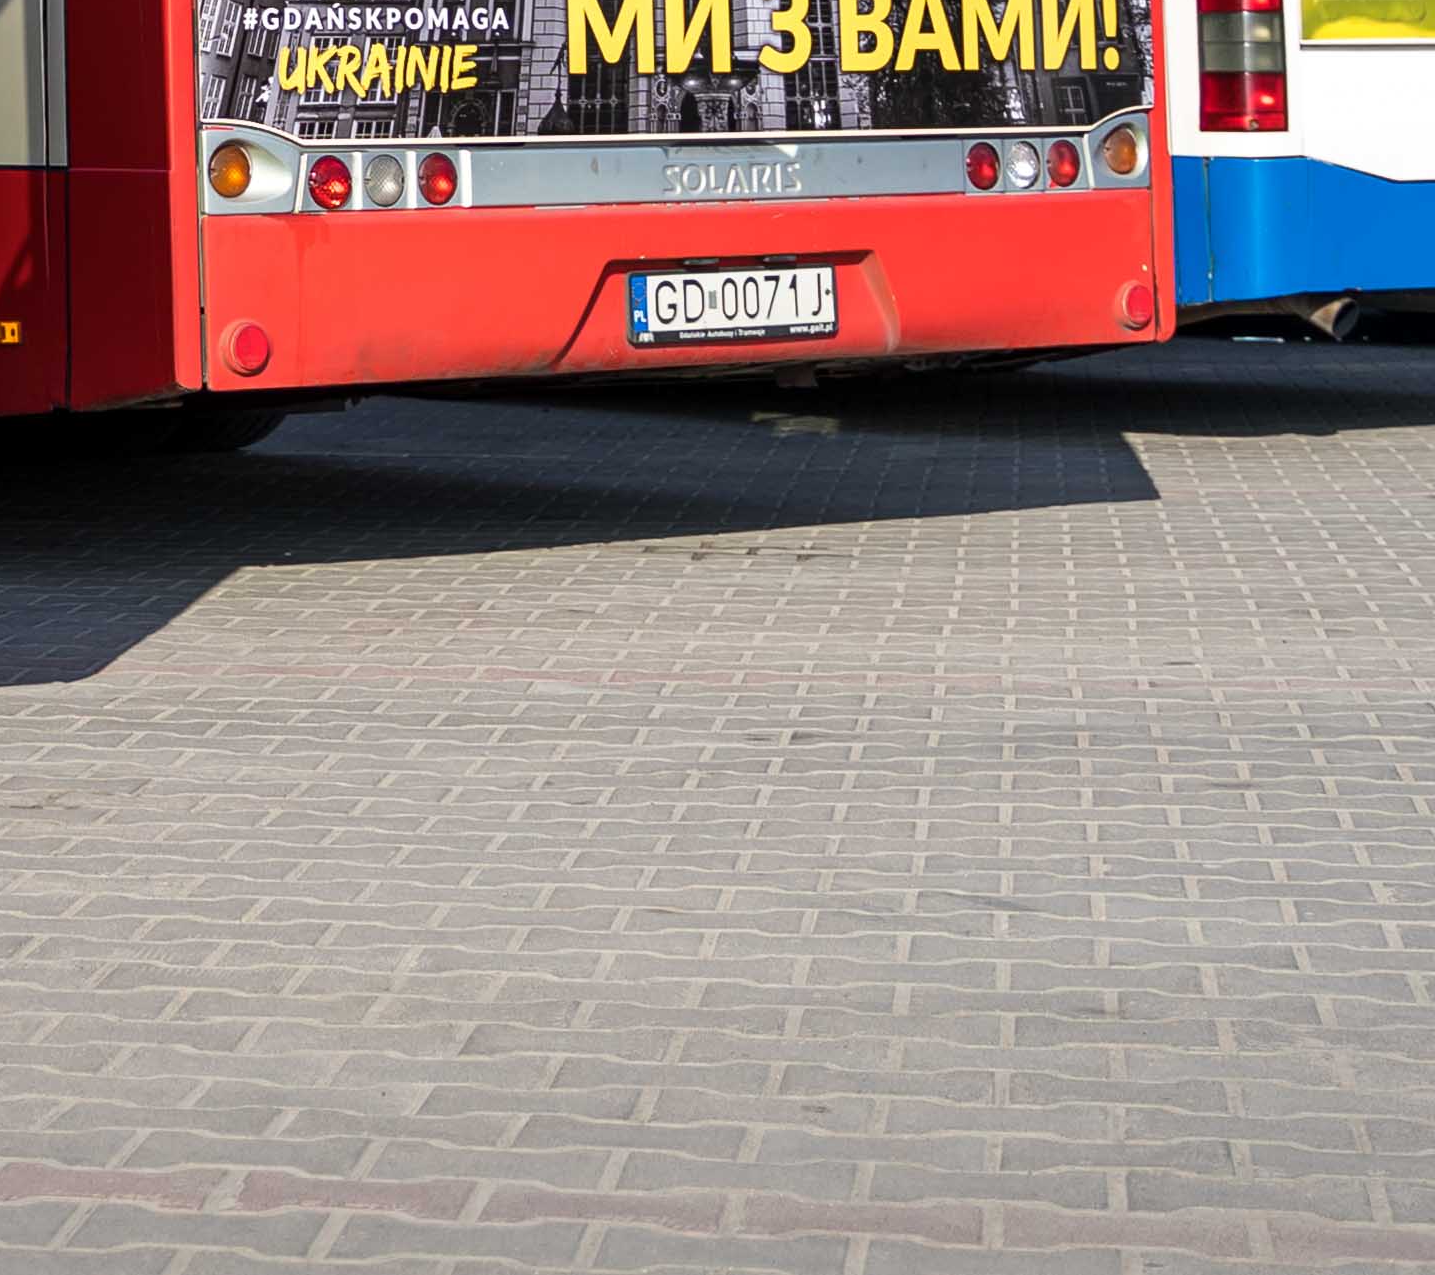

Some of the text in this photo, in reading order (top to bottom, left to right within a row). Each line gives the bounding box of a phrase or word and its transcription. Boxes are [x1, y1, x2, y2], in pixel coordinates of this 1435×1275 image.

[243, 1, 510, 31] #GDAŃSKPOMAGA
[278, 42, 478, 99] UKRAINIE
[662, 161, 802, 195] SOLARIS
[655, 272, 822, 325] GD 0071J
[634, 310, 647, 323] PL
